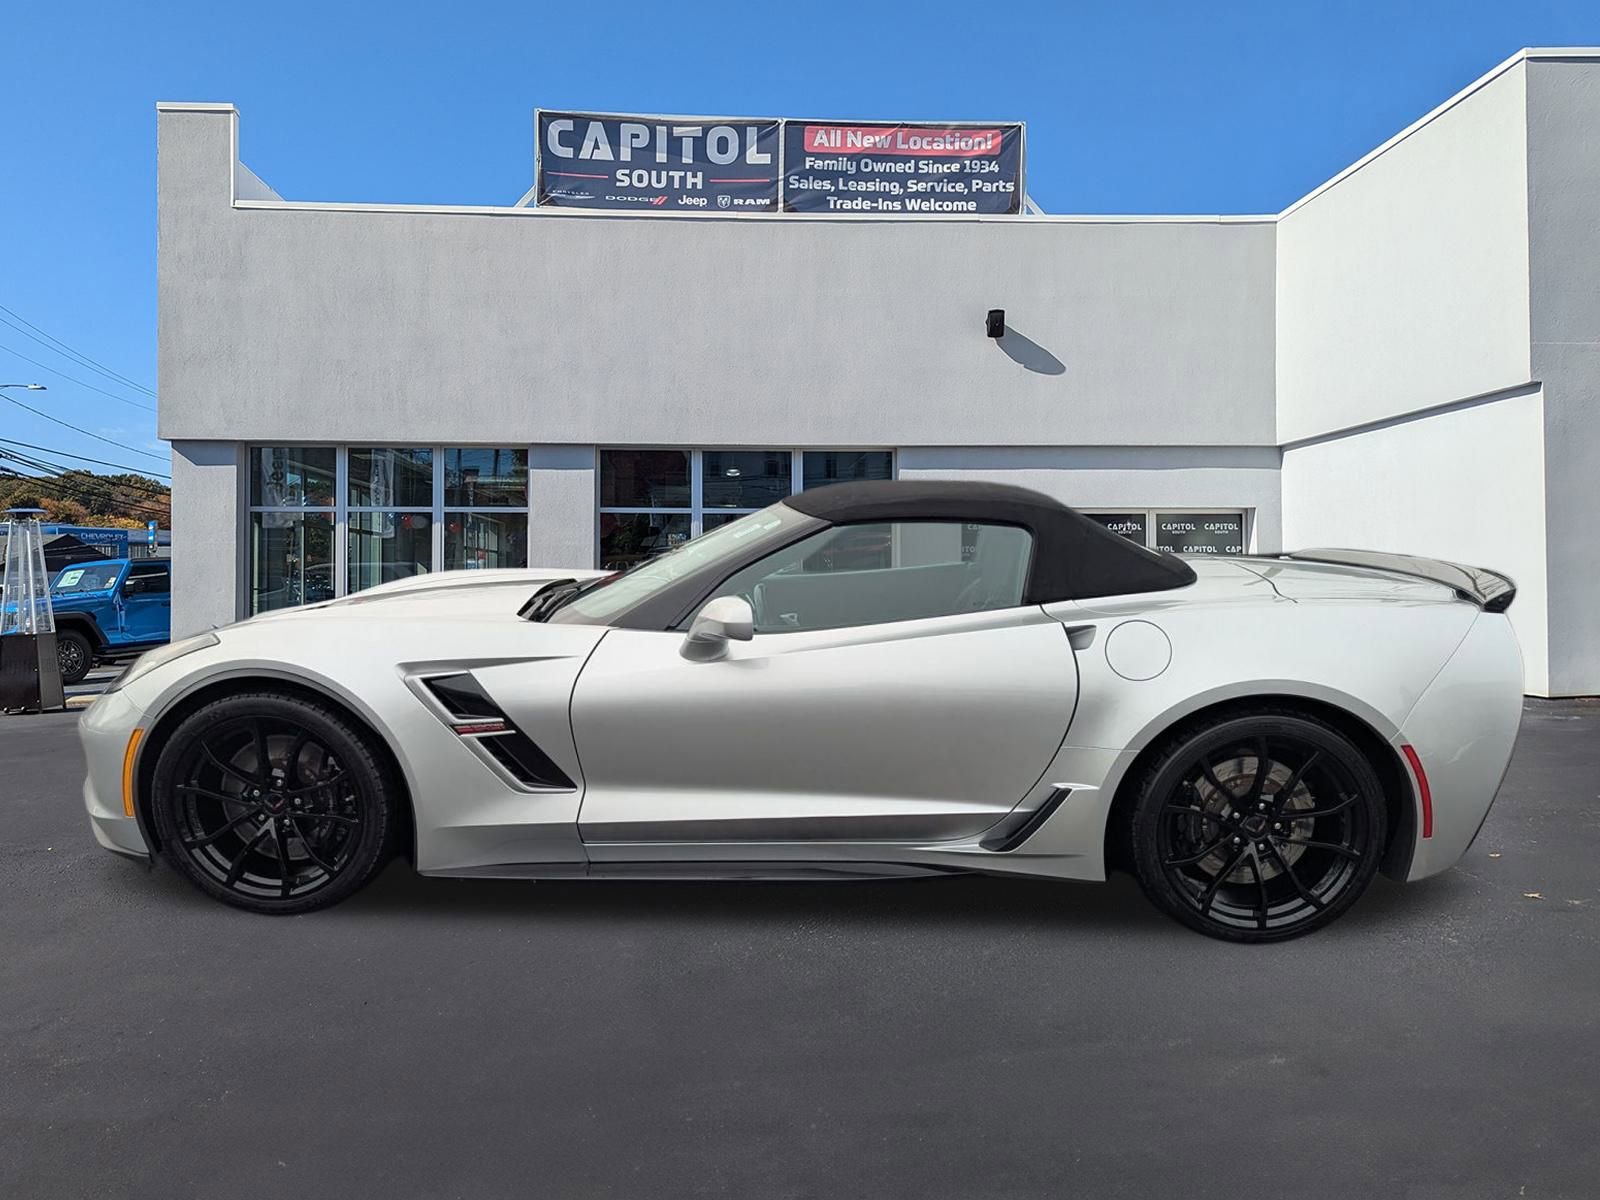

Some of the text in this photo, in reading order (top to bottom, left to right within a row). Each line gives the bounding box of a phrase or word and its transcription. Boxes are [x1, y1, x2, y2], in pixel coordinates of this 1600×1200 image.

[547, 119, 771, 165] CAPITOL
[813, 129, 993, 150] All New Location!
[805, 157, 1000, 174] Family Owned Since 1934
[615, 168, 703, 190] SOUTH
[788, 175, 1015, 195] Sales, Leasing, Service, Parts
[678, 195, 708, 207] Jeep
[826, 196, 977, 212] Trade-Ins Welcome
[1107, 523, 1142, 531] CAPITOL
[1161, 523, 1196, 531] CAPITOL
[1204, 523, 1239, 531] CAPITOL
[1183, 545, 1218, 553] CAPITOL
